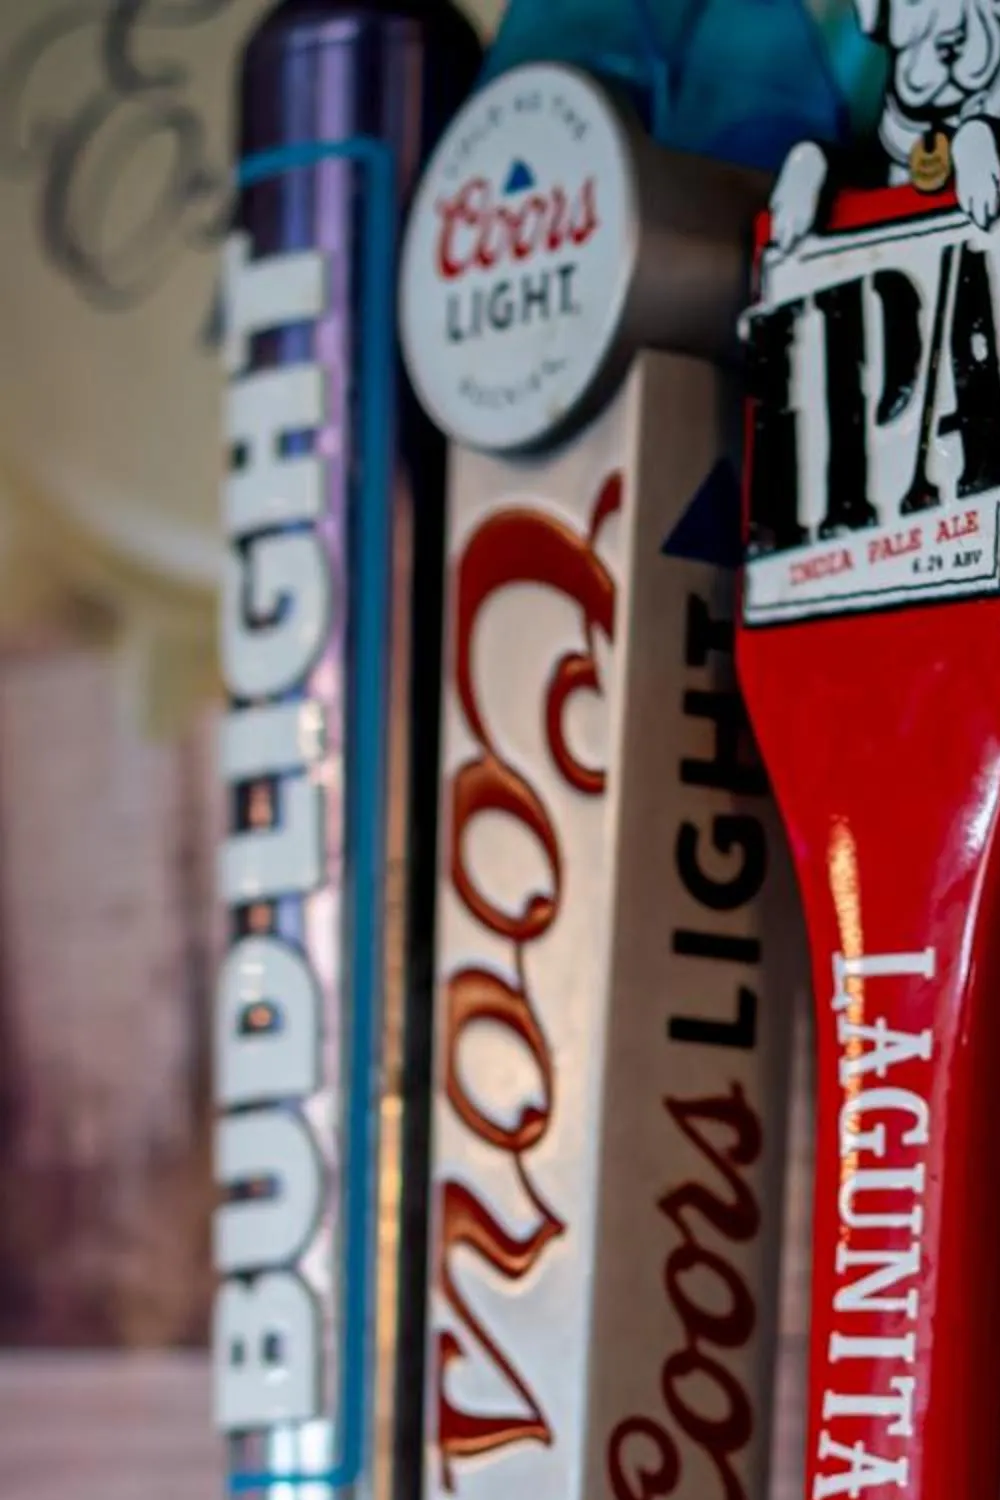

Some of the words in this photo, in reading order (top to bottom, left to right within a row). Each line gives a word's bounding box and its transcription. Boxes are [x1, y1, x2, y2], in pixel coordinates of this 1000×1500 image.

[435, 175, 600, 280] Coors
[446, 262, 580, 344] LIGHT
[217, 230, 329, 906] LIGHT
[789, 548, 854, 586] INDIA
[867, 527, 922, 564] PALE
[936, 510, 980, 544] ALE
[953, 549, 983, 568] ABV
[666, 592, 772, 1056] LIGHT
[437, 466, 626, 1494] Coors
[213, 935, 323, 1434] BUD
